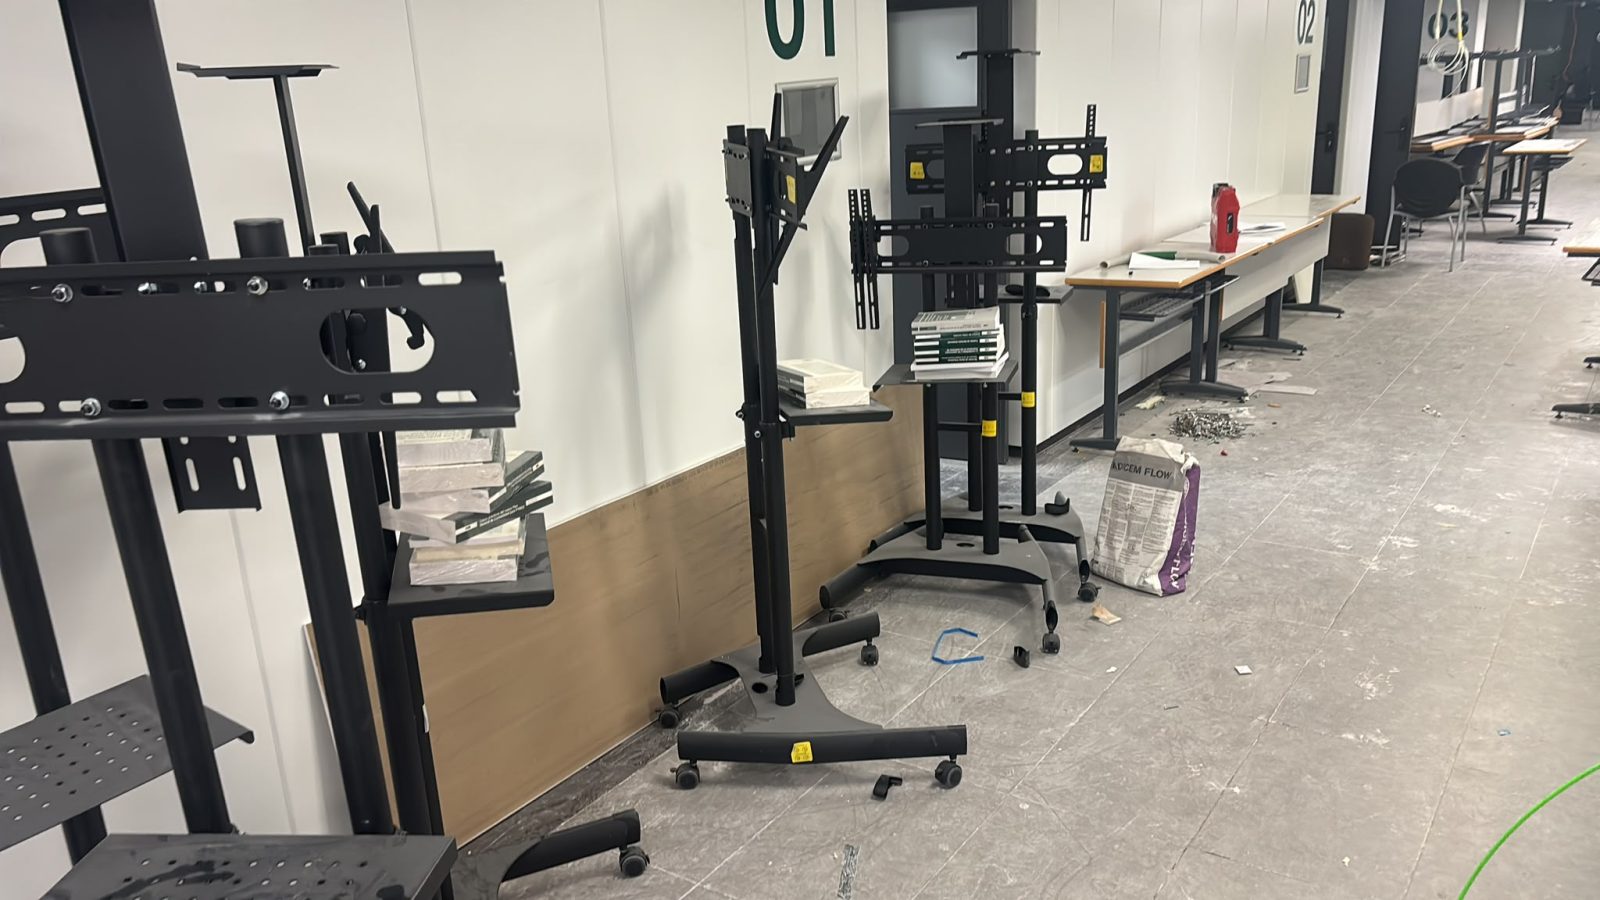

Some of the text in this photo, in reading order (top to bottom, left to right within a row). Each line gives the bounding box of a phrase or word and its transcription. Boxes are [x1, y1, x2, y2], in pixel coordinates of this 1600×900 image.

[1297, 0, 1316, 45] 02
[1427, 10, 1470, 39] 03
[1144, 467, 1172, 480] FLOW
